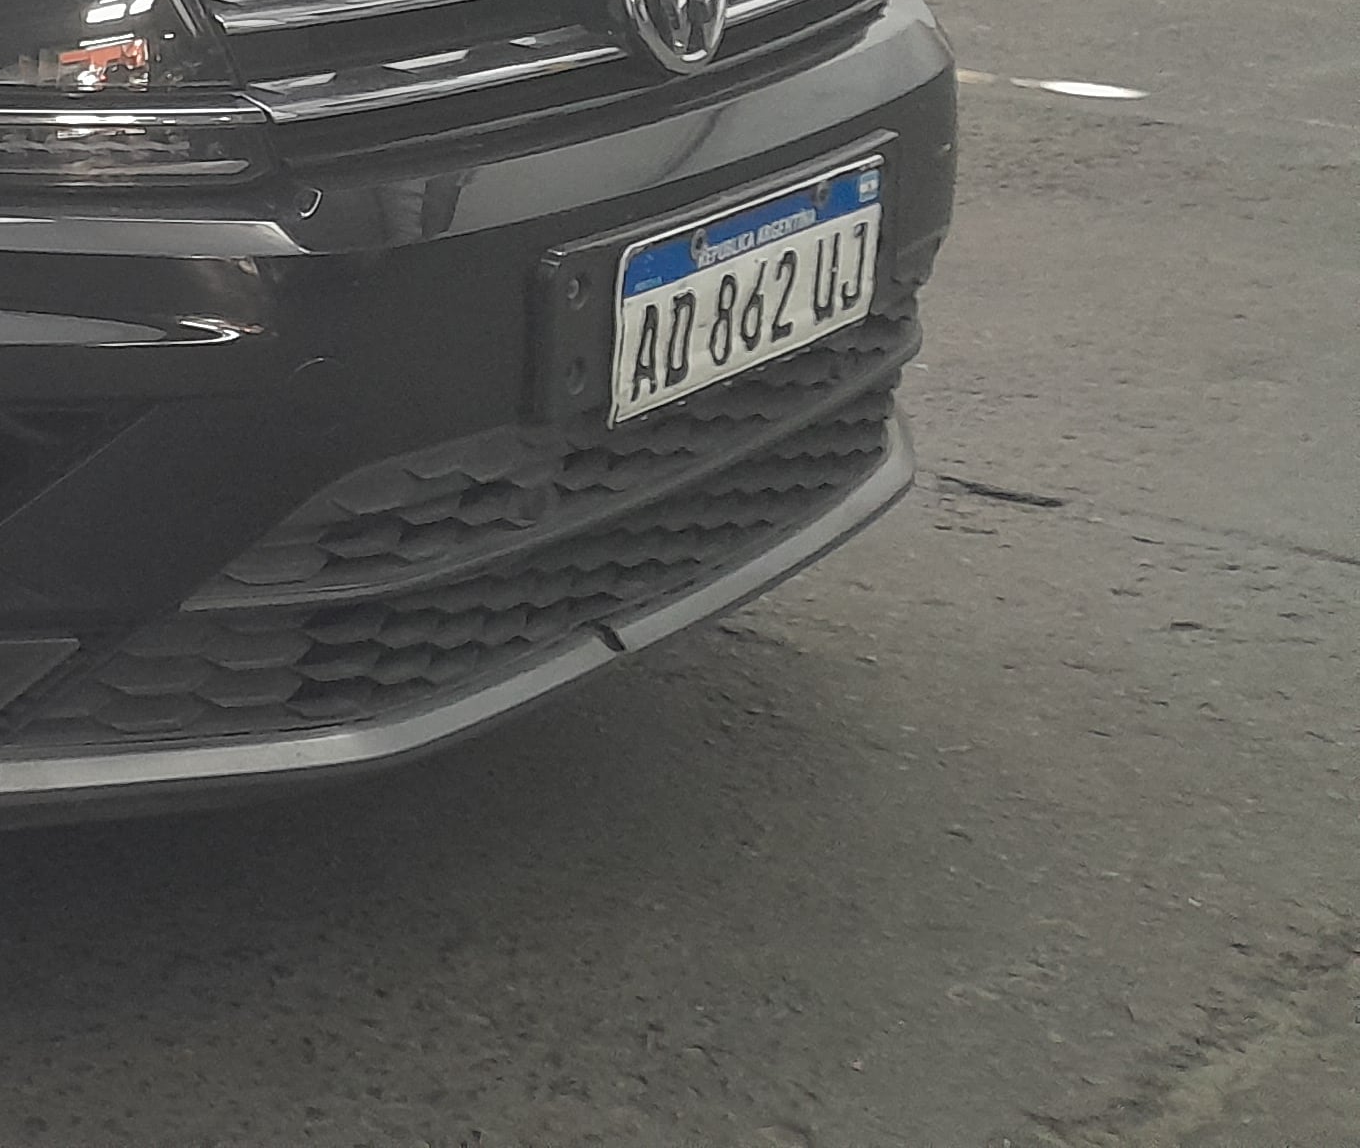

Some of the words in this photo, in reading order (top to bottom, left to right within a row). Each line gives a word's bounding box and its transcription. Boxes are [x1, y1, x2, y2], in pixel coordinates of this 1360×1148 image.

[630, 290, 697, 403] AD
[709, 249, 798, 366] 862
[814, 221, 868, 325] UJ
